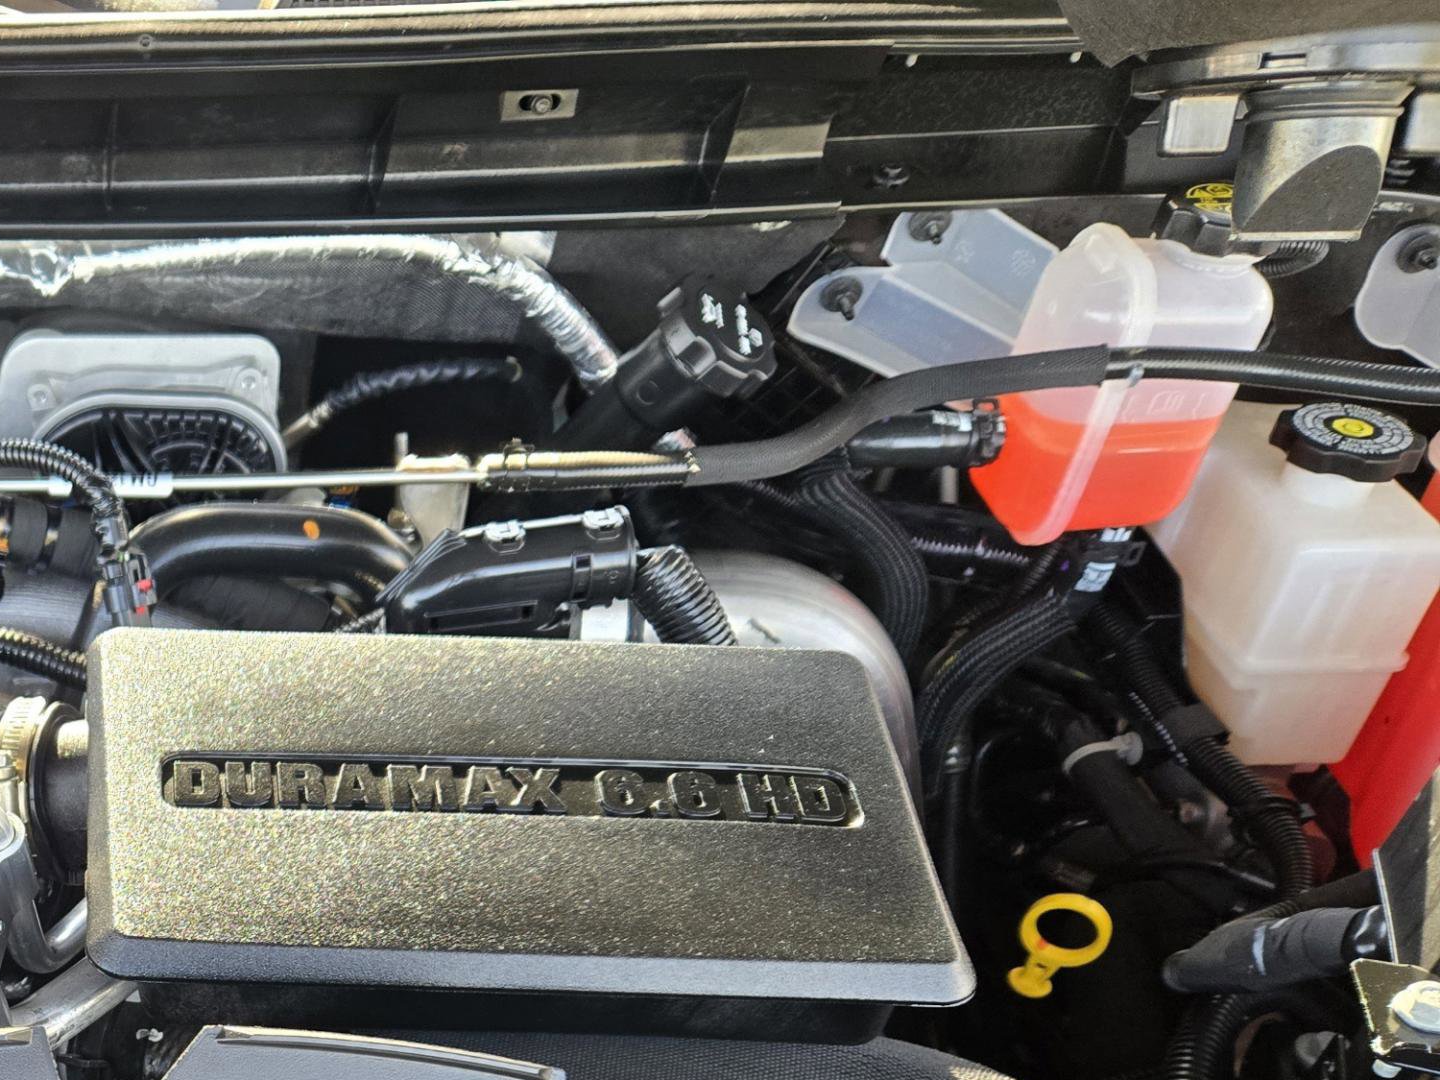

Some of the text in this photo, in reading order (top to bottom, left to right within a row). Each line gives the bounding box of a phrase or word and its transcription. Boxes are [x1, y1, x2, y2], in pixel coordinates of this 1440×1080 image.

[171, 760, 848, 824] DURAMAX 6.6 HD
